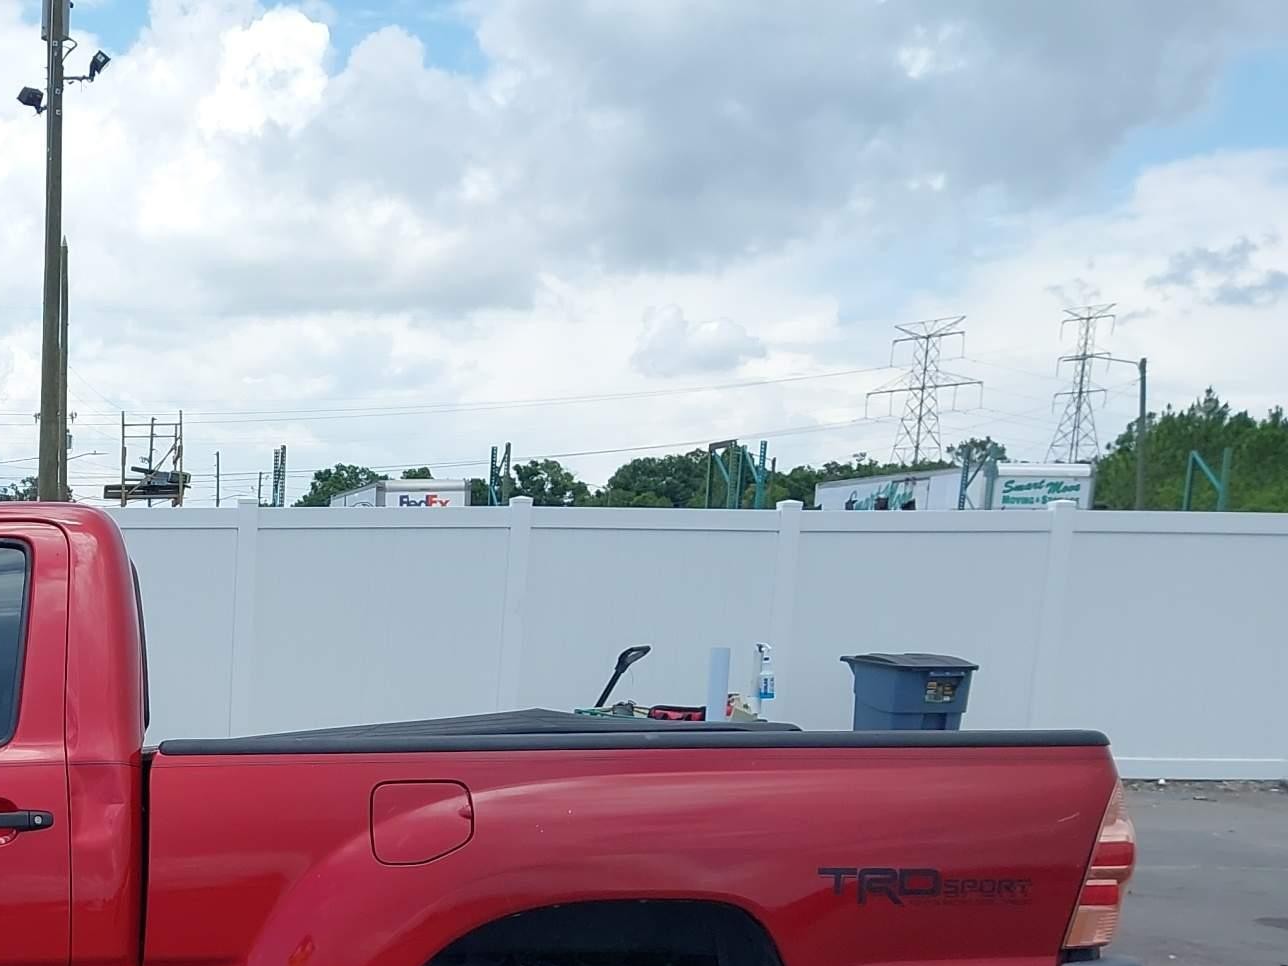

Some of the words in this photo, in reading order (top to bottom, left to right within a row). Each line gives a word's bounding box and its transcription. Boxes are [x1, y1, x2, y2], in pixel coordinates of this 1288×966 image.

[399, 494, 450, 507] FedEx
[817, 867, 943, 907] TRD
[943, 878, 1034, 898] SPORT
